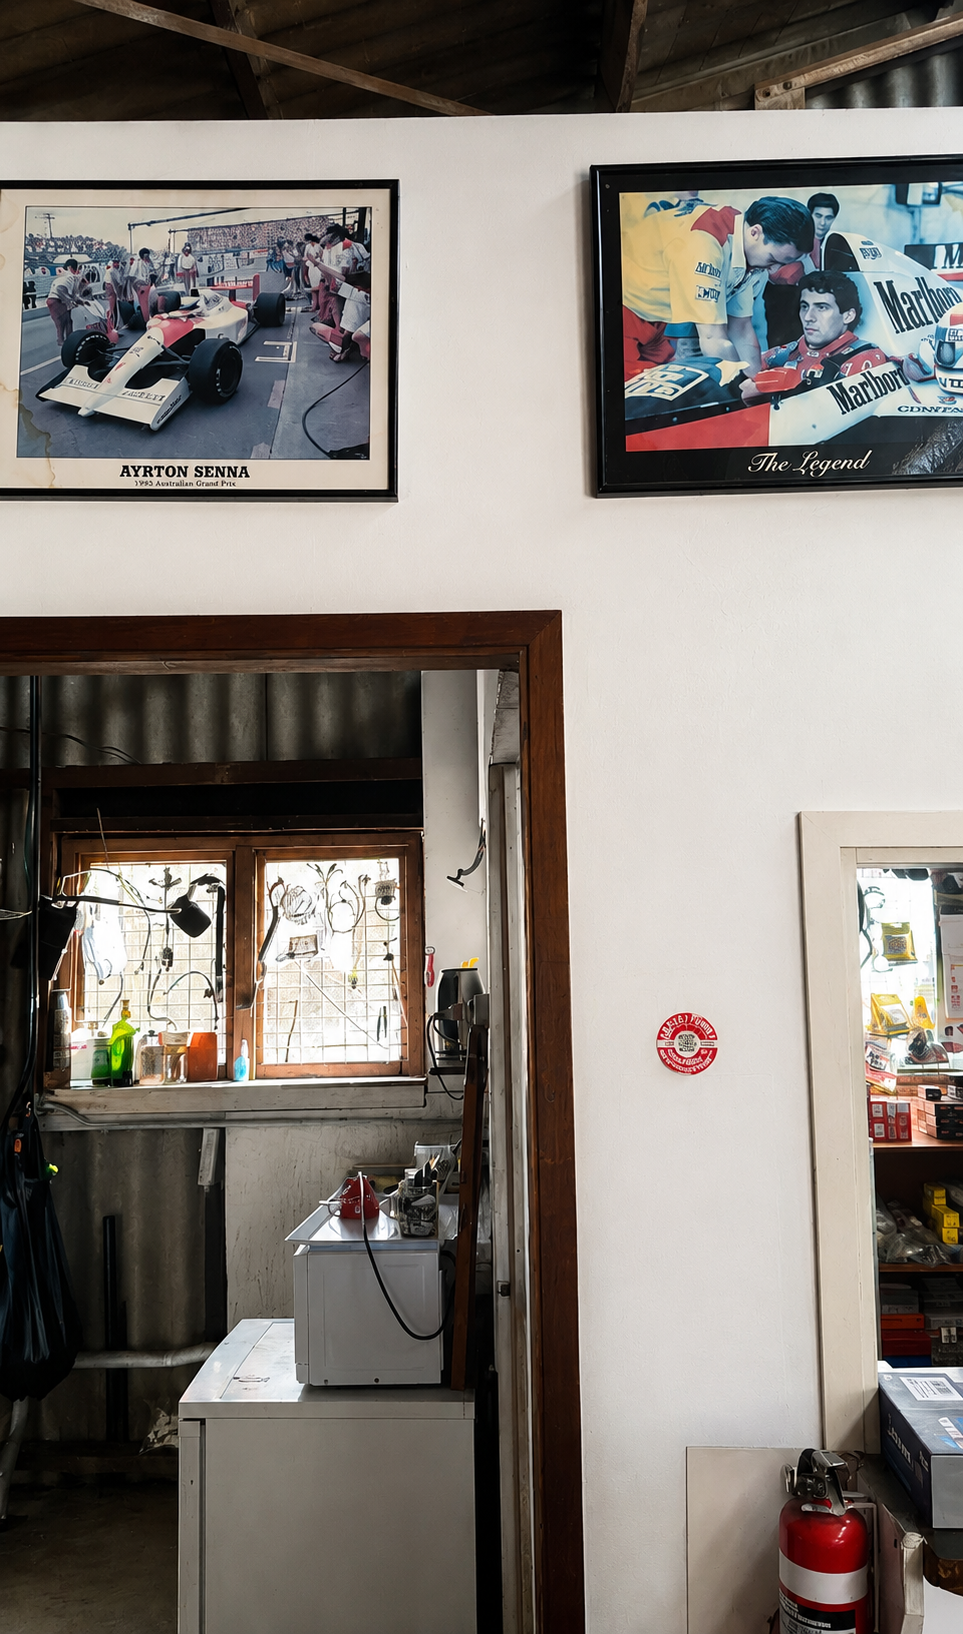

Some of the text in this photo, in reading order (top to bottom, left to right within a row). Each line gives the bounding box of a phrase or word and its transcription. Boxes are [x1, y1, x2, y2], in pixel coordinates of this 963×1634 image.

[747, 449, 873, 478] The Legend
[119, 464, 250, 478] AYRTON SENNA
[155, 479, 194, 487] Australian
[196, 479, 219, 487] Grand
